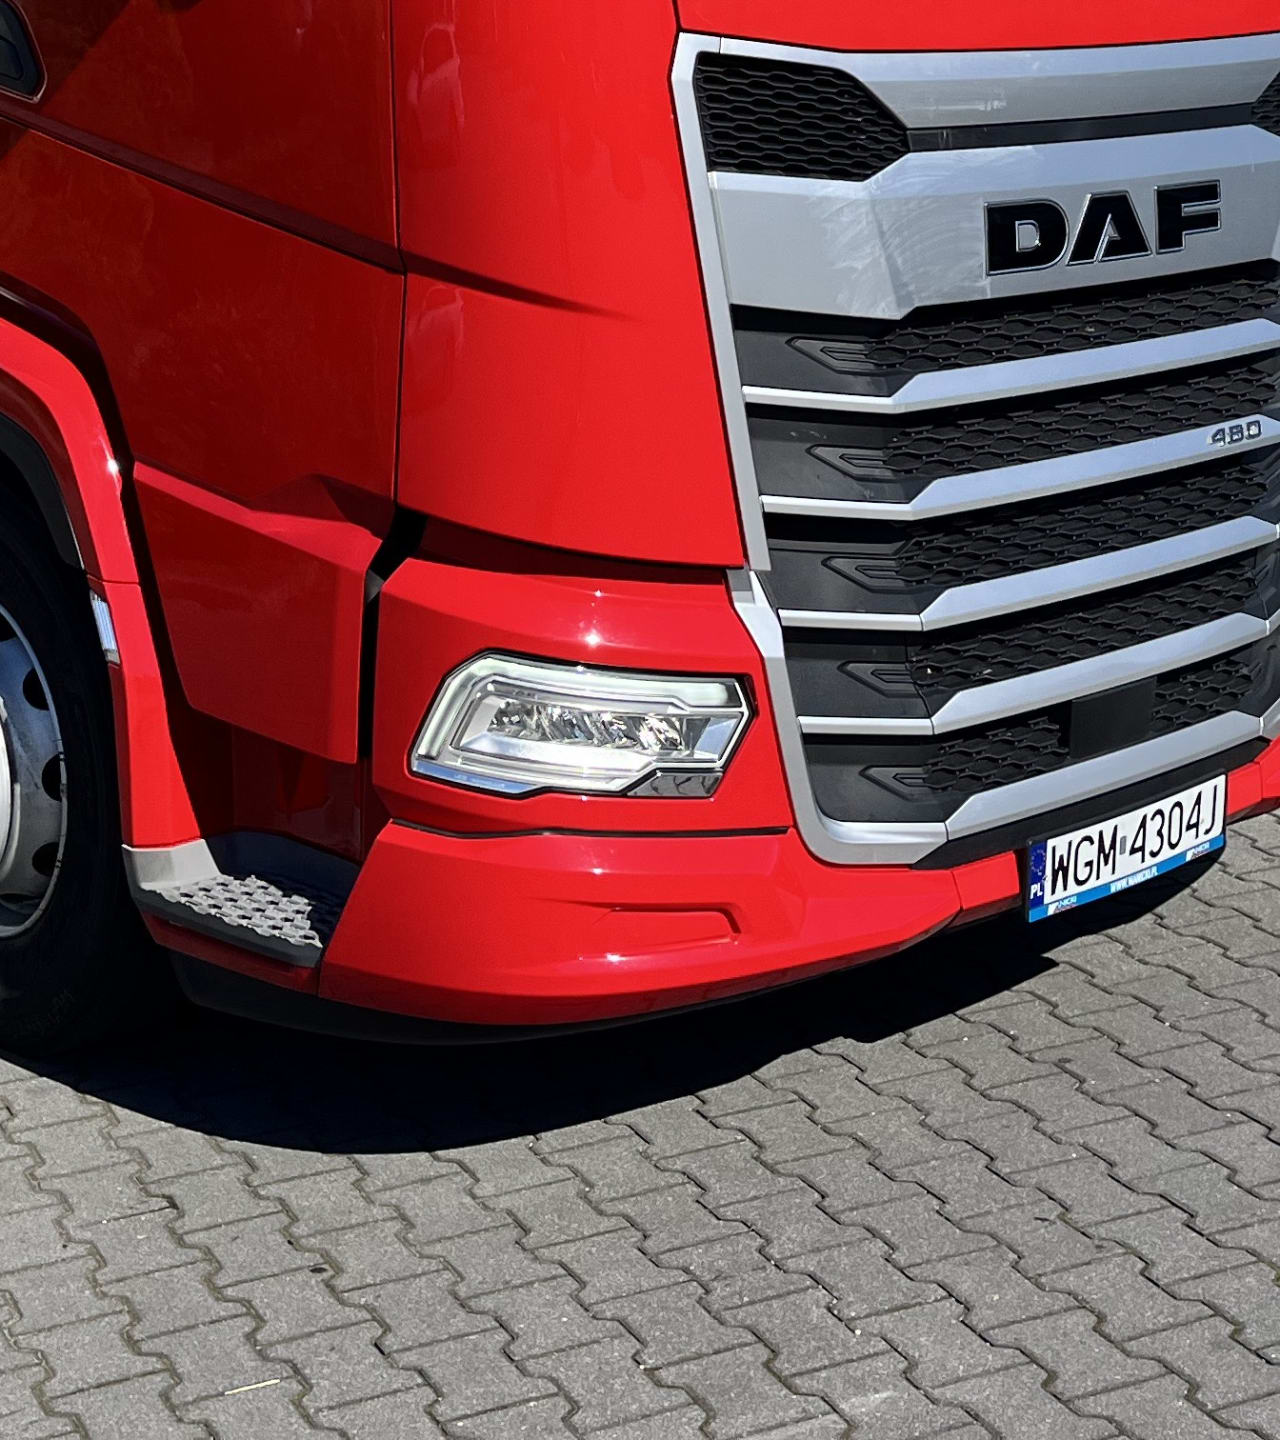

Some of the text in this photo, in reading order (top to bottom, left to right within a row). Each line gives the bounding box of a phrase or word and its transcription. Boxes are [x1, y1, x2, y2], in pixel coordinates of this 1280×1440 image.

[984, 179, 1221, 277] DAF
[1050, 784, 1218, 896] WGM 4304J
[1029, 882, 1043, 900] PL
